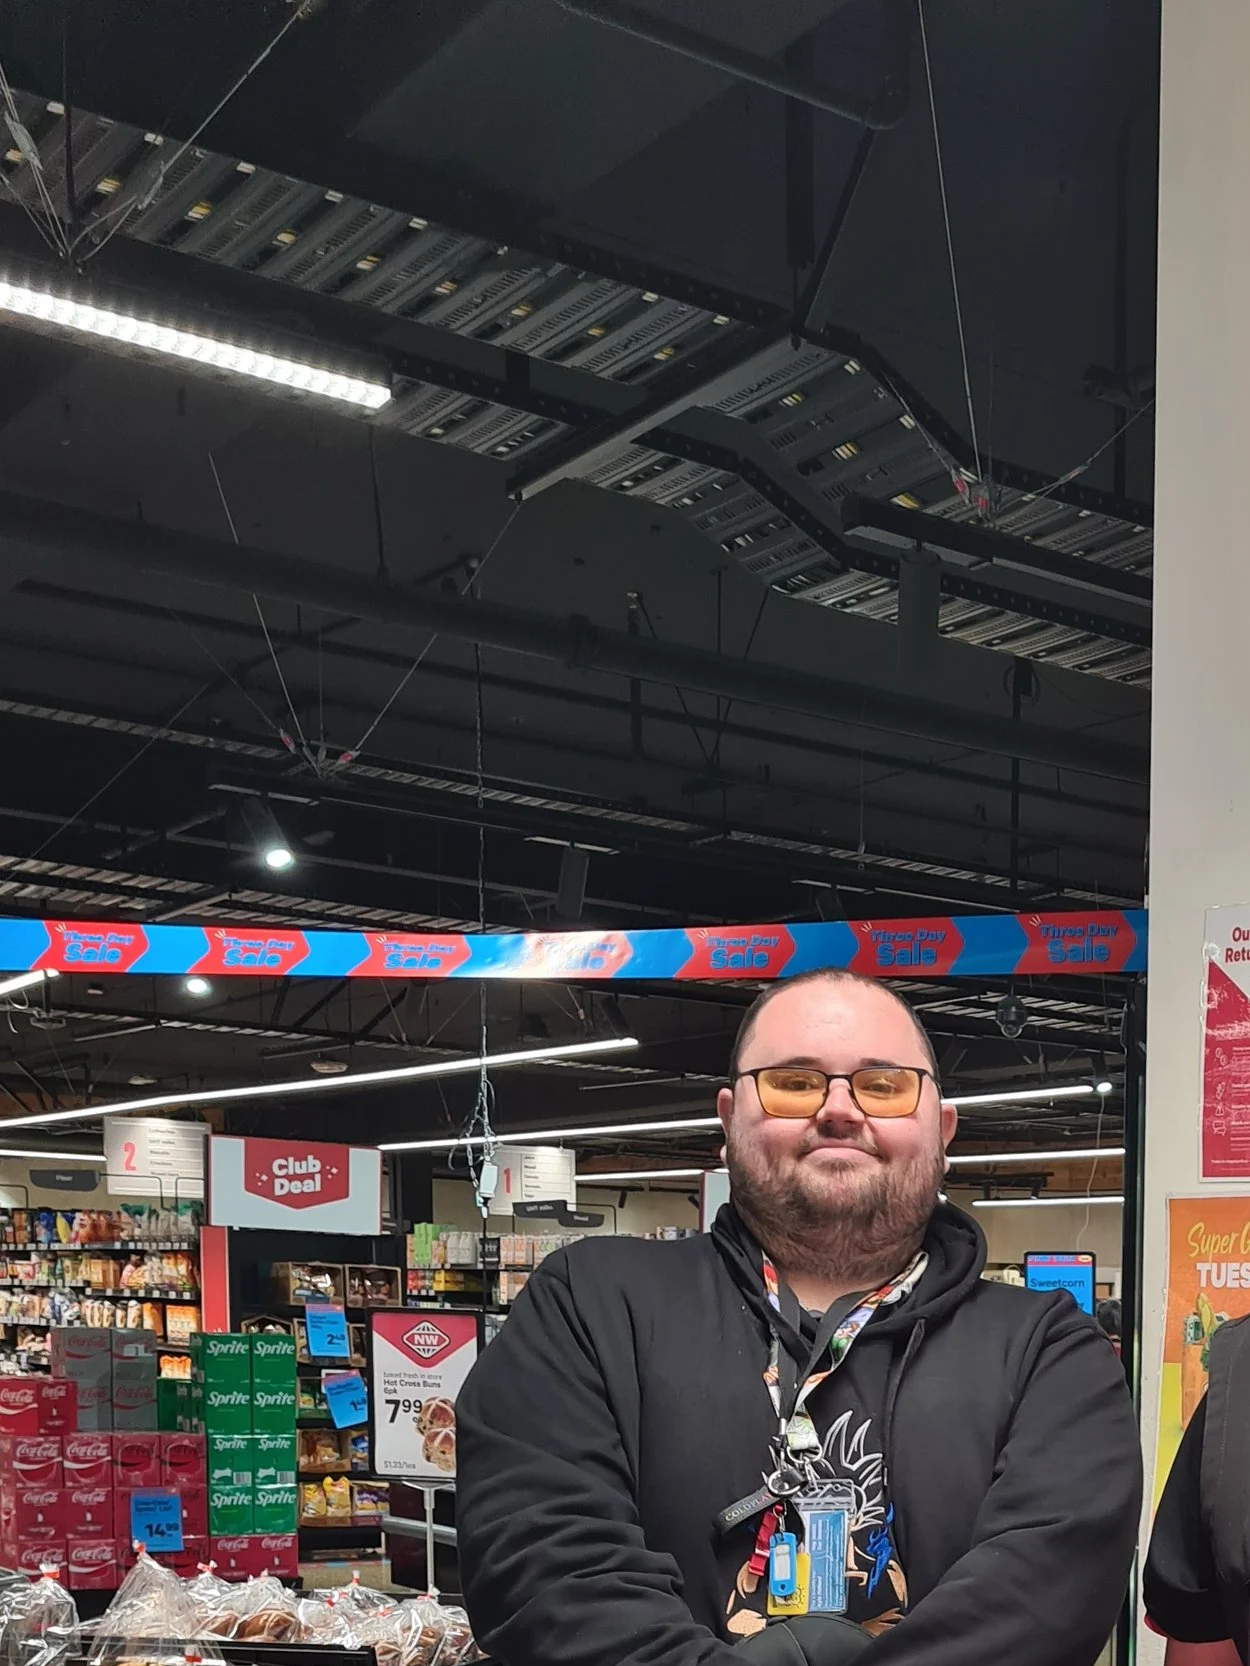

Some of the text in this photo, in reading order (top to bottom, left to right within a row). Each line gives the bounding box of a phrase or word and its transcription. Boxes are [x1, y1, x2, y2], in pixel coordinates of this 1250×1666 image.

[871, 928, 945, 944] Three Day
[1040, 923, 1118, 939] Three Day
[706, 934, 780, 949] Three Day
[64, 943, 122, 964] Sale
[223, 948, 283, 968] Sale
[710, 947, 769, 970] Sale
[875, 942, 937, 966] Sale
[1047, 938, 1109, 963] Sale
[384, 953, 443, 970] Sale
[121, 1142, 136, 1171] 2
[271, 1155, 321, 1176] Club
[273, 1174, 321, 1197] Deal
[504, 1168, 511, 1194] 1
[1187, 1222, 1240, 1262] Super
[1030, 1278, 1085, 1288] Sweetcorn
[206, 1340, 250, 1355] Sprite
[413, 1333, 439, 1346] NW
[254, 1341, 295, 1356] Sprite
[423, 1381, 441, 1389] Buns
[207, 1391, 250, 1406] Sprite
[254, 1391, 295, 1406] Sprite
[214, 1438, 248, 1450] Sprite
[258, 1438, 291, 1450] Sprite
[211, 1492, 252, 1508] Sprite
[255, 1491, 296, 1508] Sprite
